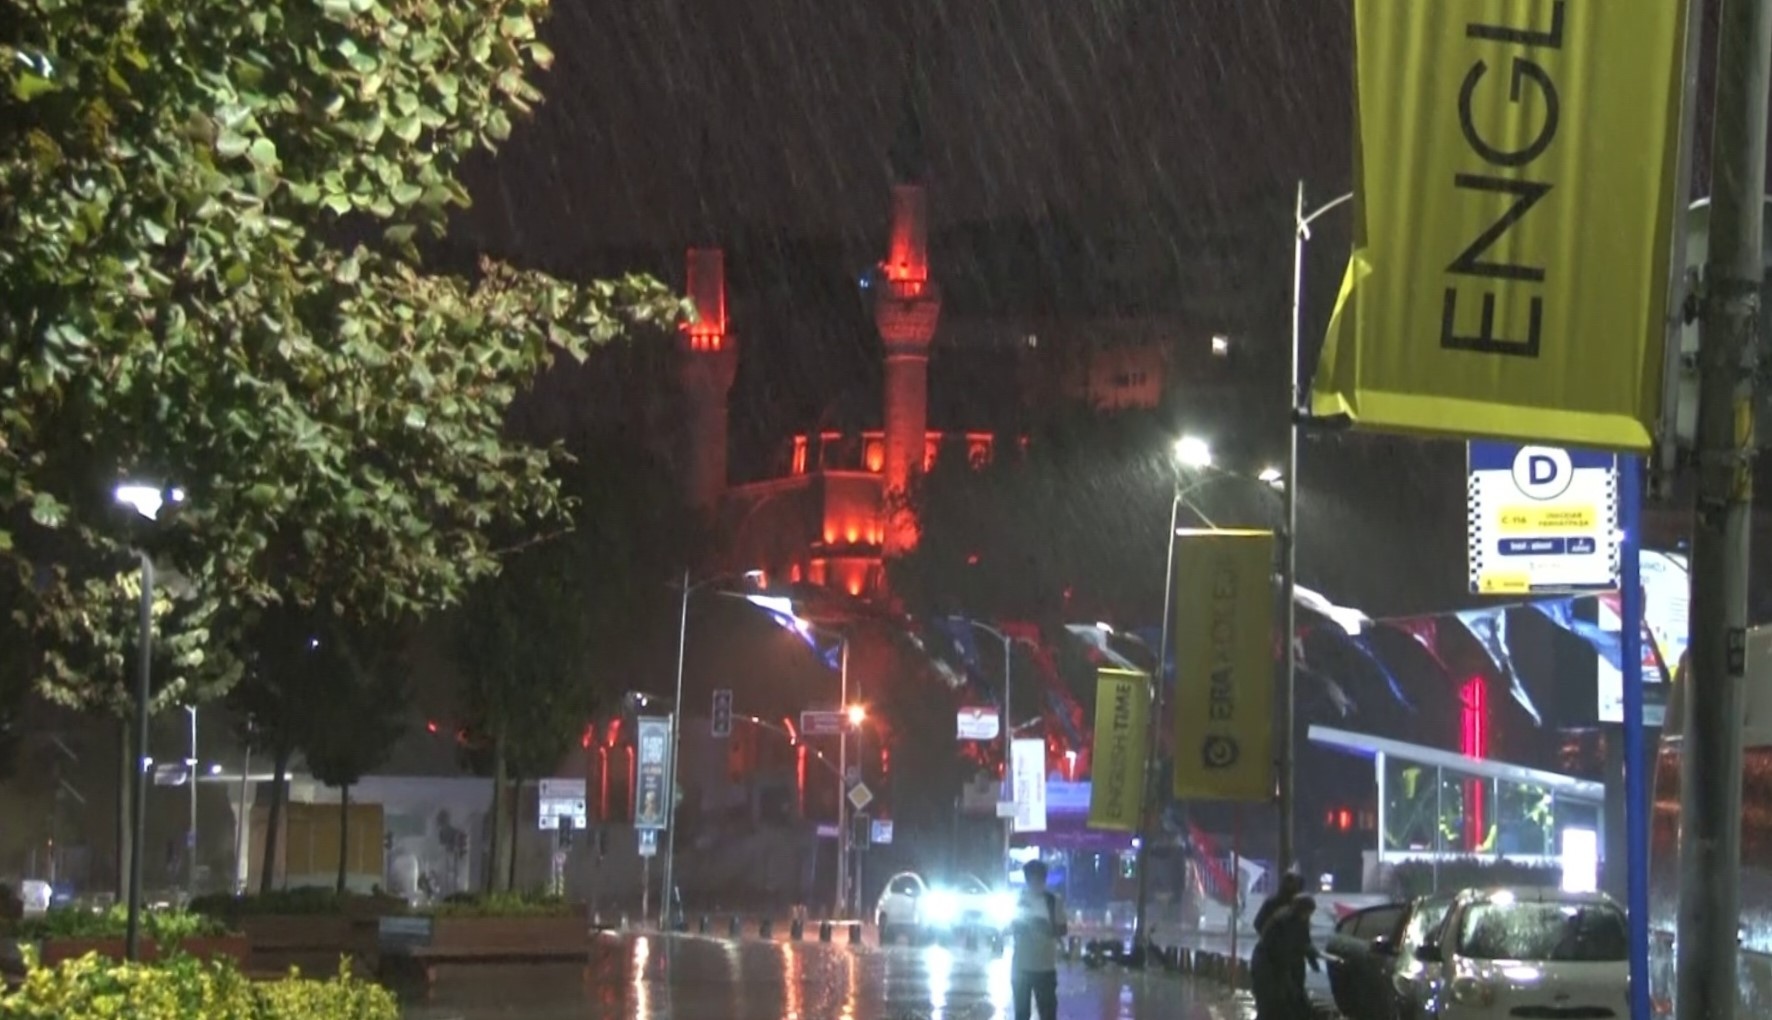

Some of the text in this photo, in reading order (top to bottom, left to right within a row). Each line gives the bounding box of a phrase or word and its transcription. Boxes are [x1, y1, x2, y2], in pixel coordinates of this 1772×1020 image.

[1440, 1, 1565, 358] ENGL
[1529, 455, 1558, 485] D
[1113, 683, 1132, 731] TIME
[1209, 667, 1234, 721] ERA
